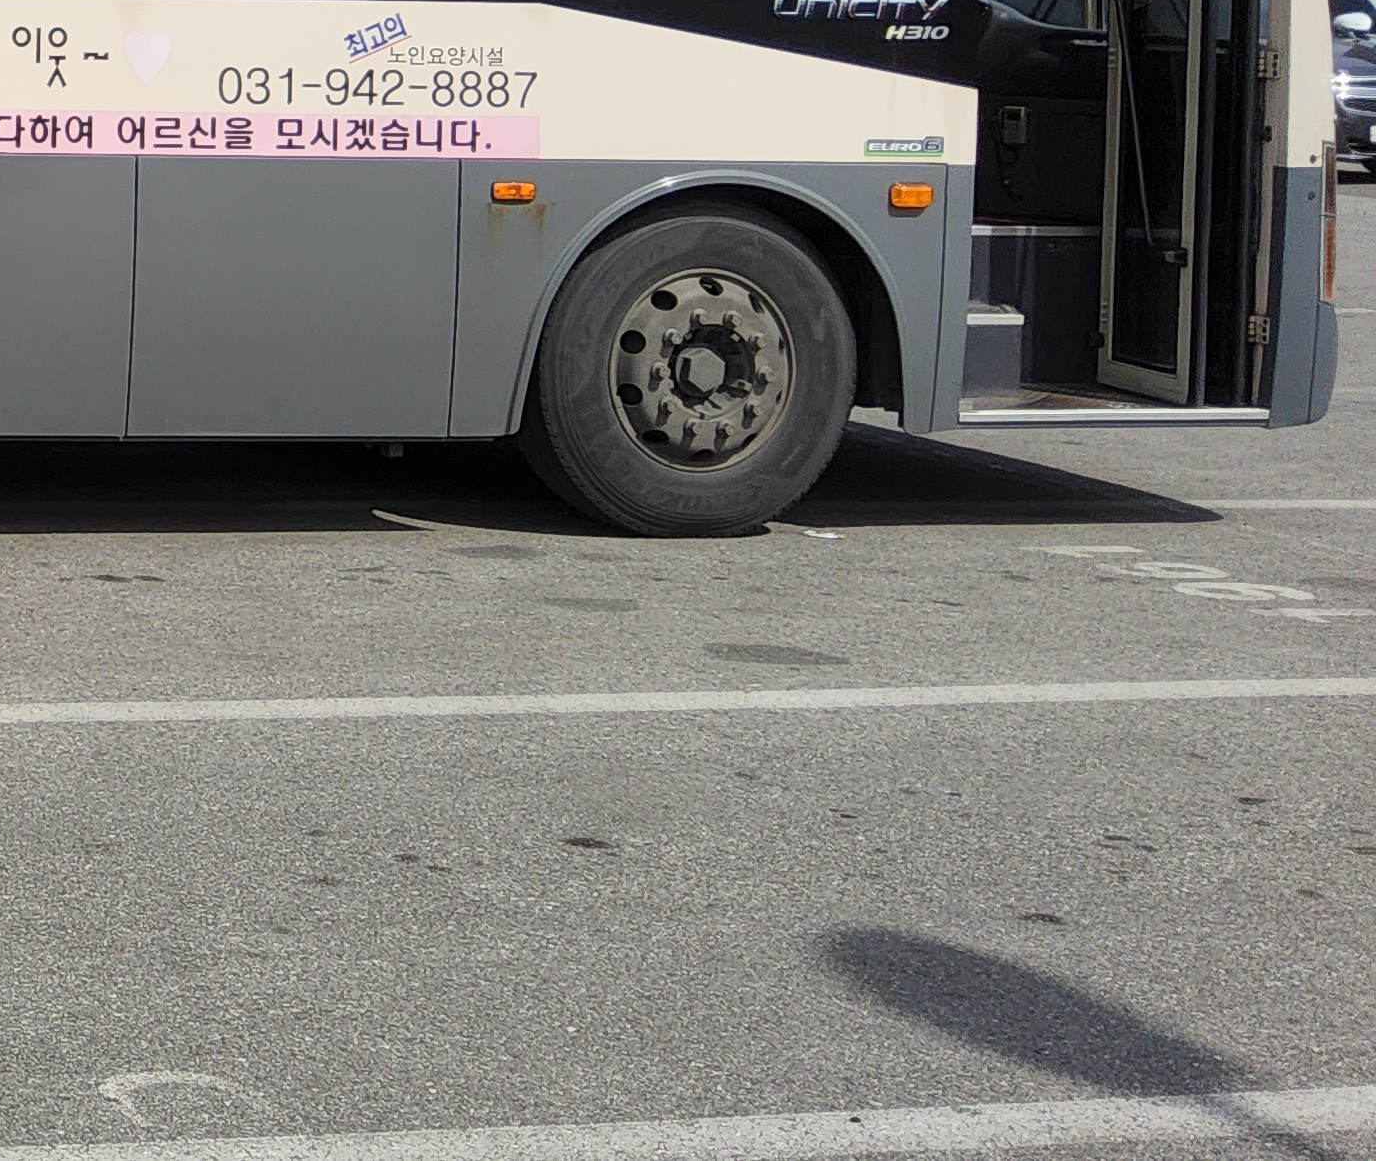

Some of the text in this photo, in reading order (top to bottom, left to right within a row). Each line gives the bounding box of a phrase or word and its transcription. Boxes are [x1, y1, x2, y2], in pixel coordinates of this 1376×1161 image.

[344, 13, 408, 57] 최고의
[886, 25, 949, 40] H310
[387, 46, 504, 67] 노인요양시설
[218, 66, 538, 109] 031-942-8887
[117, 116, 254, 151] 어르신을
[276, 118, 492, 153] 모시겠습니다.
